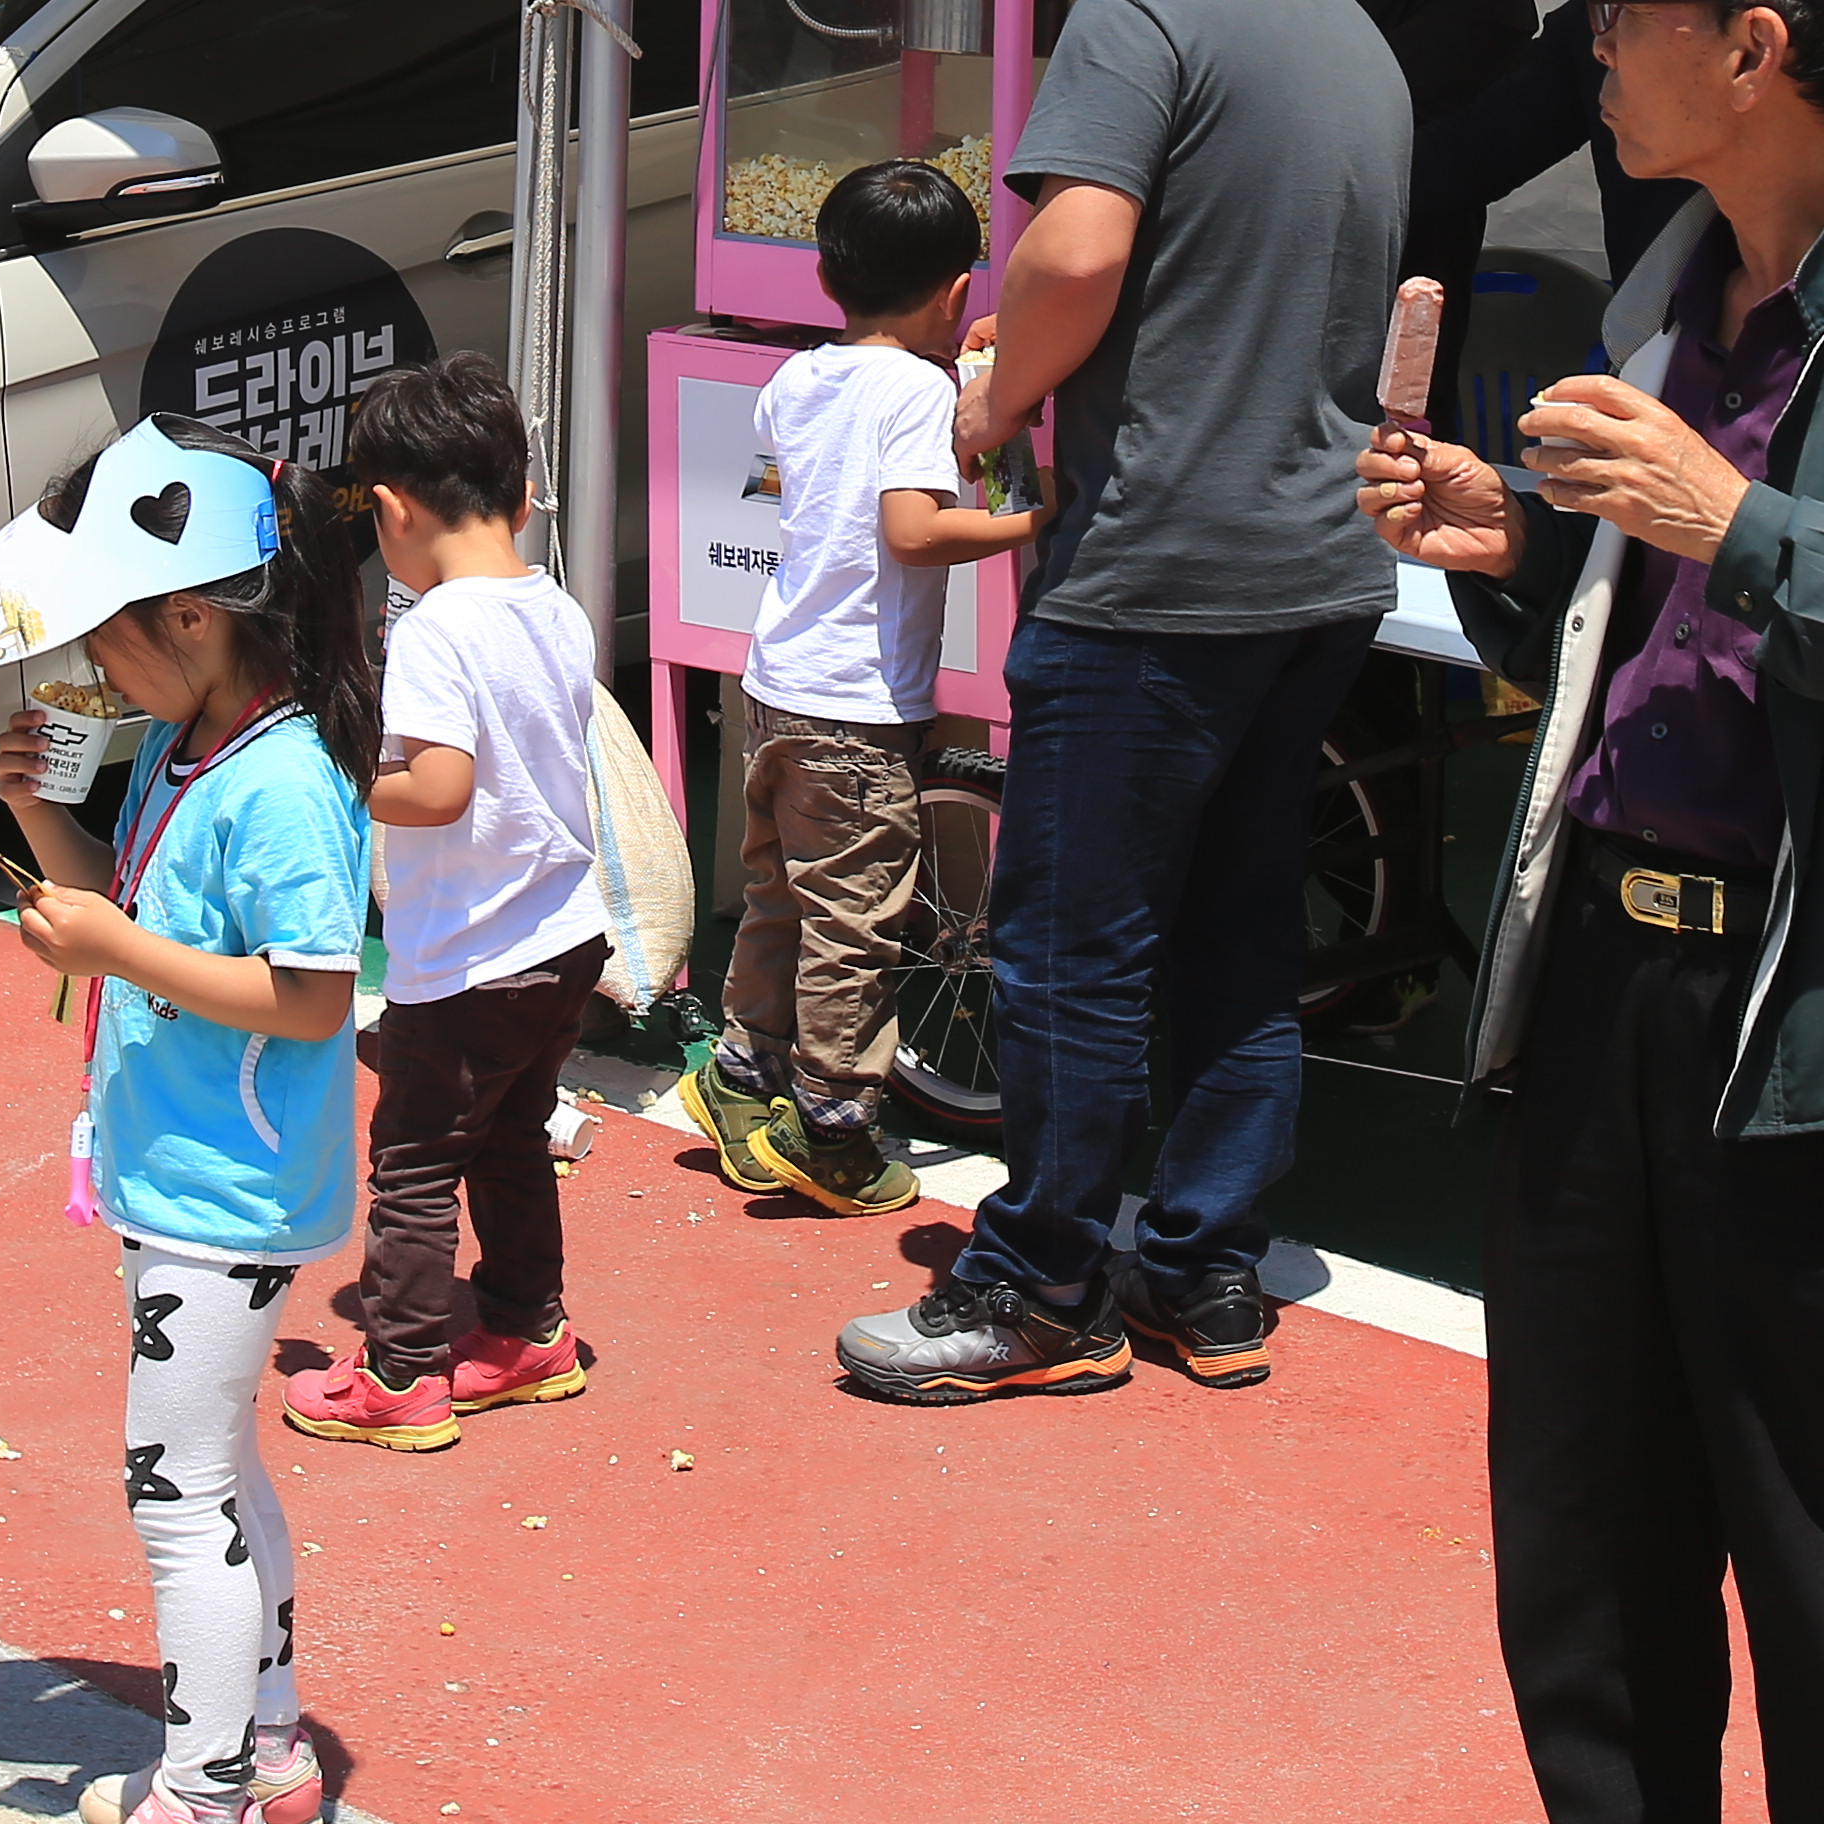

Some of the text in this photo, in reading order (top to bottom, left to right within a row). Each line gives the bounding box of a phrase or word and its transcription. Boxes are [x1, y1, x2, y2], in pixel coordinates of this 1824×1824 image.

[195, 323, 395, 428] 드라이브
[708, 541, 785, 577] 쉐보레자동
[147, 993, 178, 1021] Kids
